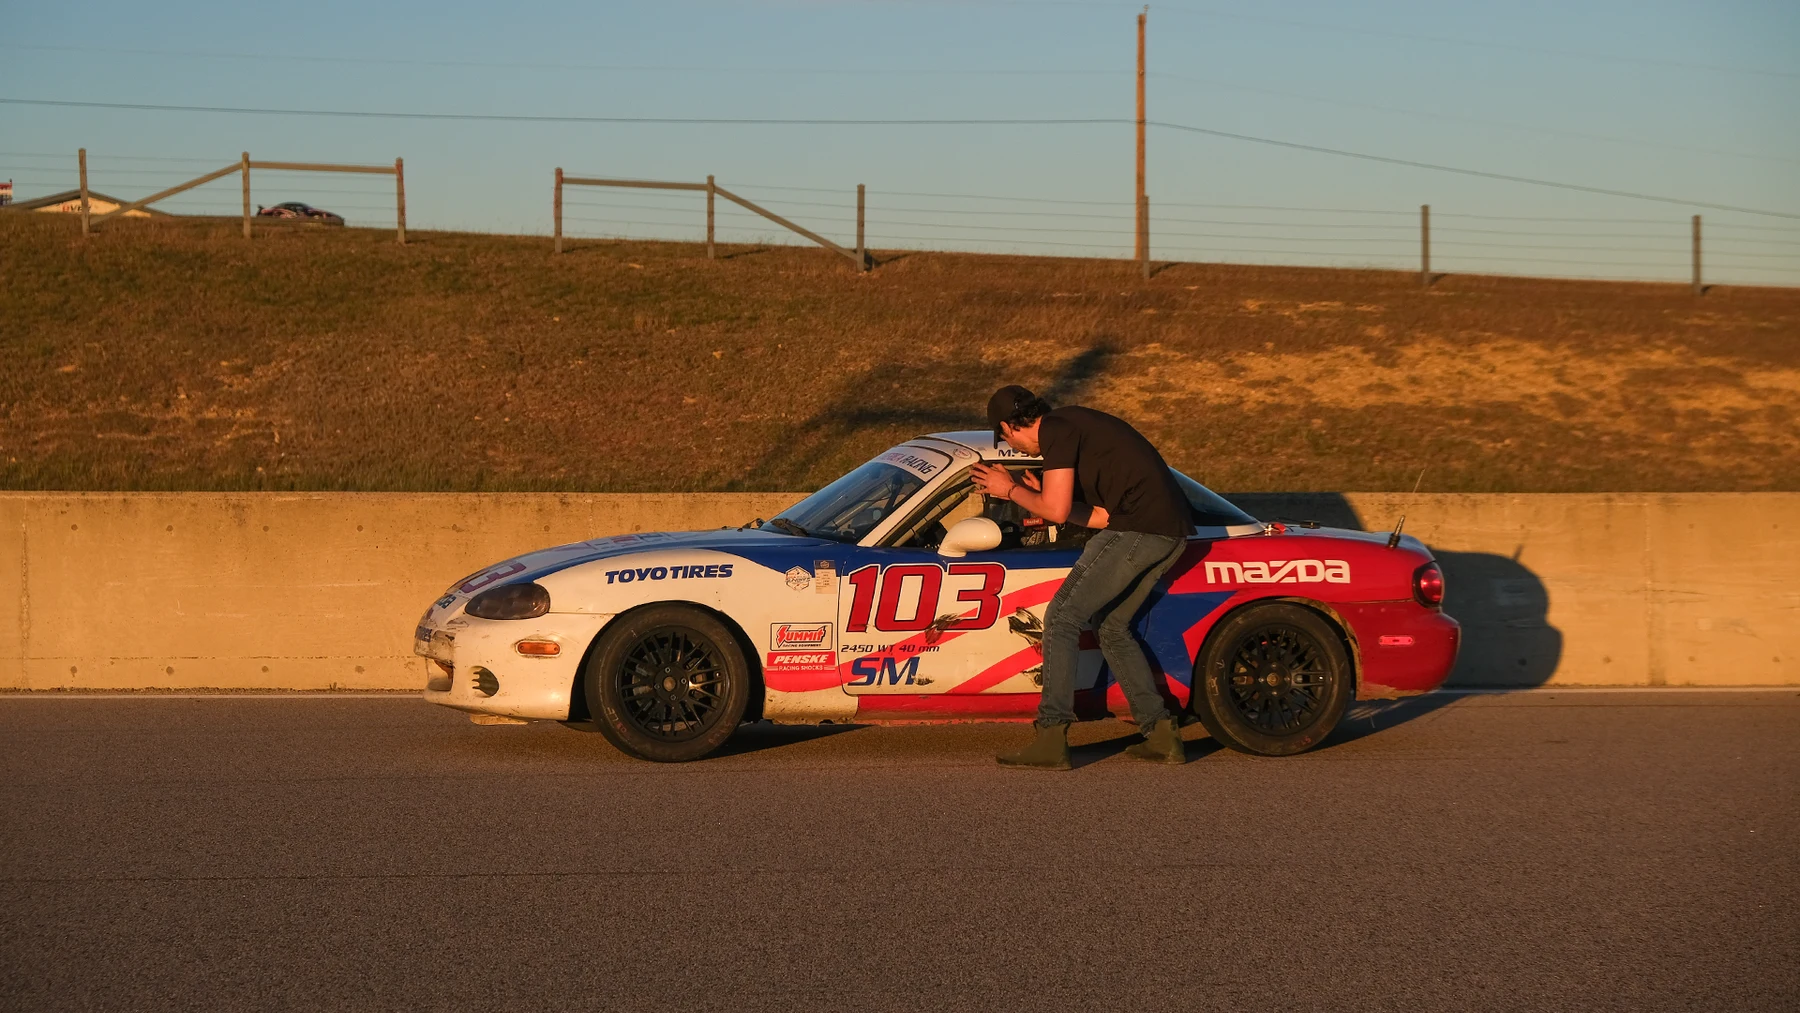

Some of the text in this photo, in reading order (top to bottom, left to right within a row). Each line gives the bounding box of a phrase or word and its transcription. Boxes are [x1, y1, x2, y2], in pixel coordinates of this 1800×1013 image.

[605, 564, 733, 584] TOYO TIRES
[846, 564, 1005, 632] 103
[841, 644, 940, 653] 2450 WT 40 mm
[773, 654, 829, 664] PENSKE
[847, 656, 920, 686] SM
